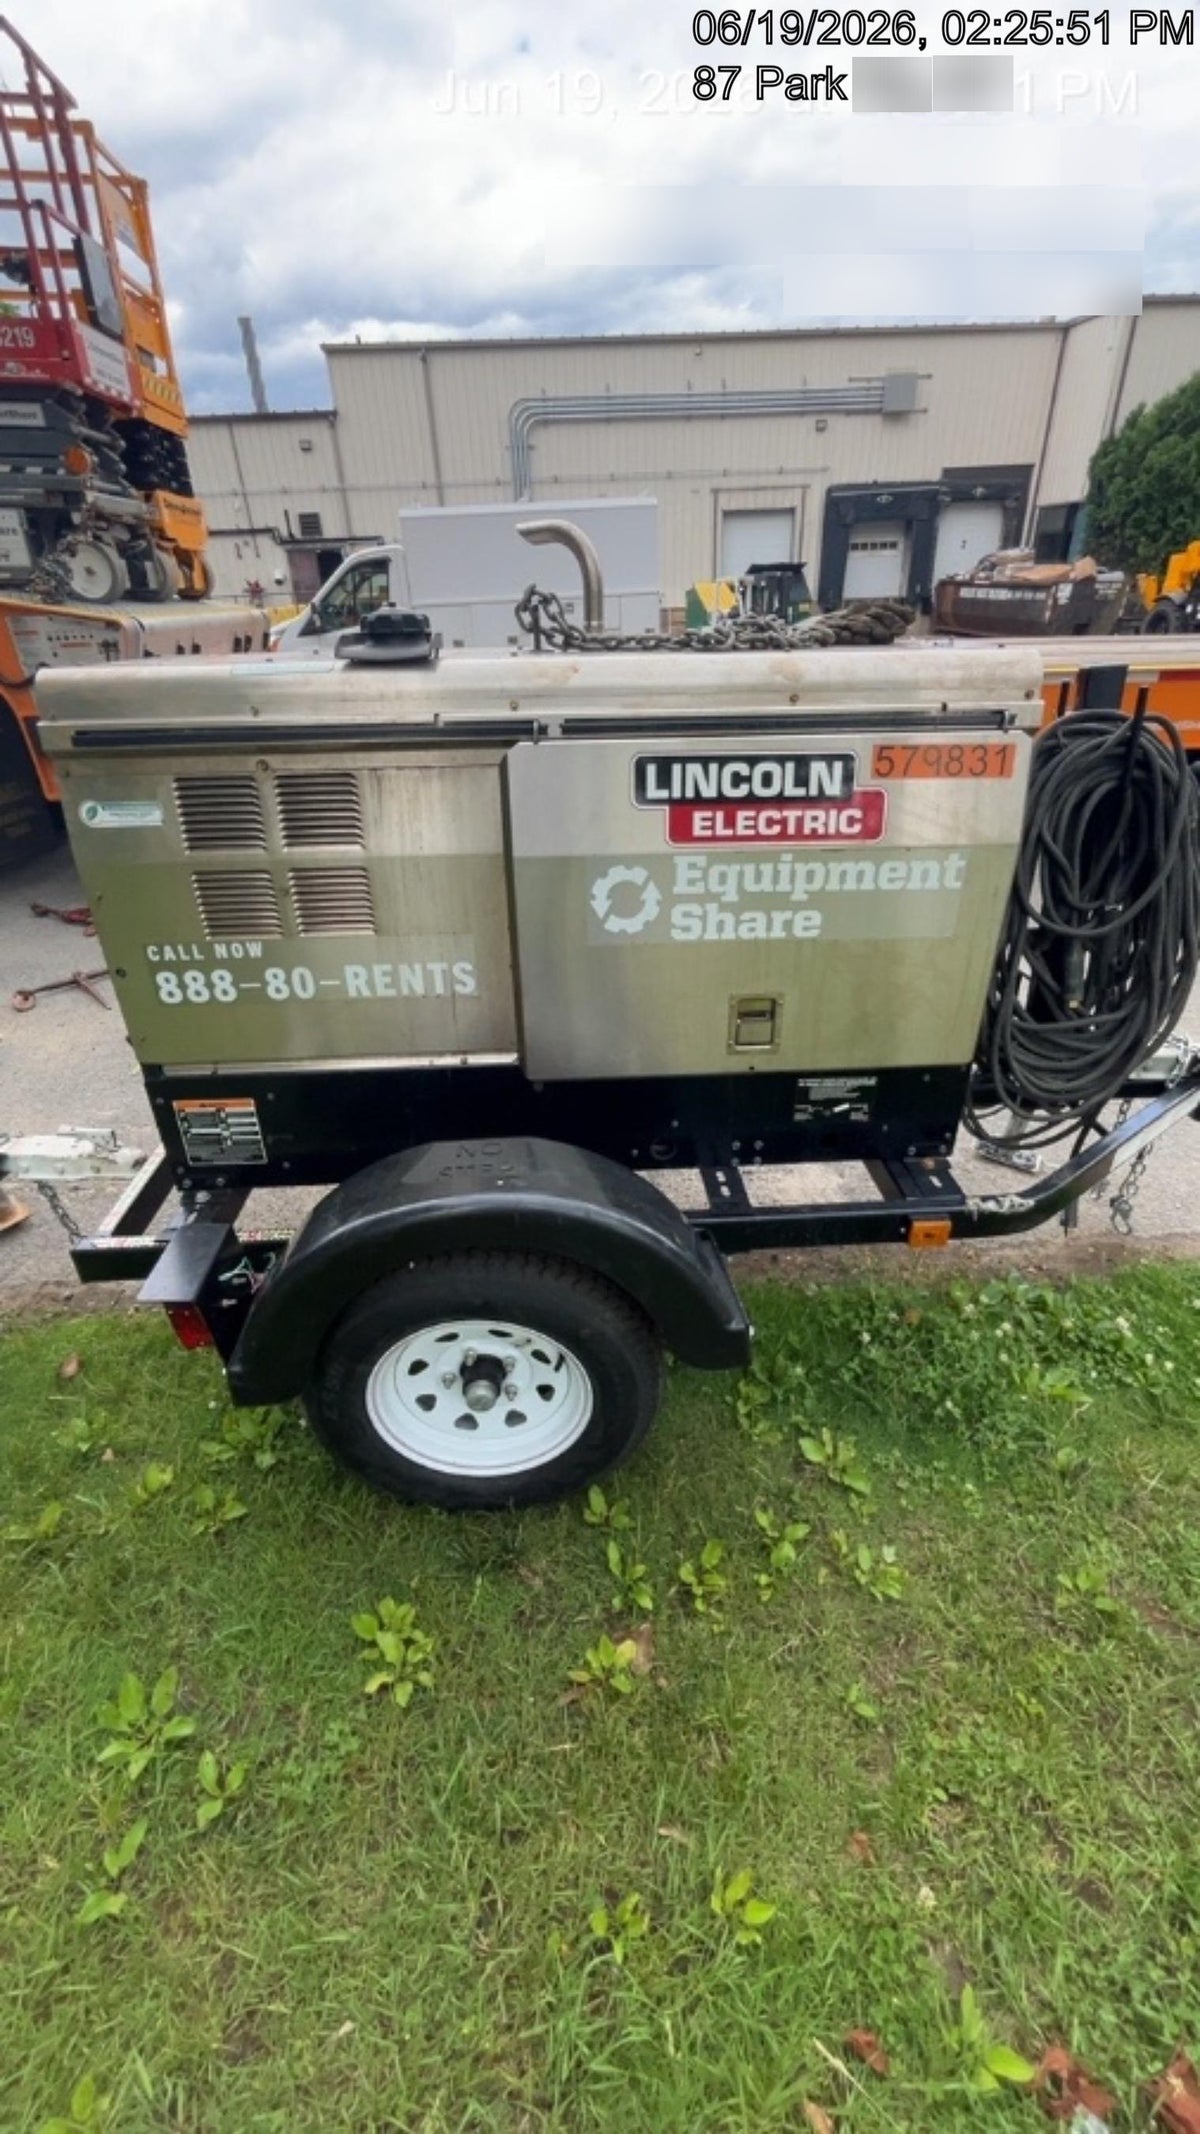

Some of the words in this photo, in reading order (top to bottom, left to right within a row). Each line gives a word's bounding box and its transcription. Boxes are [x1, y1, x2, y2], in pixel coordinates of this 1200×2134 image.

[874, 745, 1010, 777] 579831
[645, 760, 844, 800] LINCOLN
[691, 808, 865, 838] ELECTRIC
[671, 852, 969, 902] Equipment
[670, 902, 823, 941] Share
[146, 945, 205, 961] CALL
[213, 941, 263, 959] NOW
